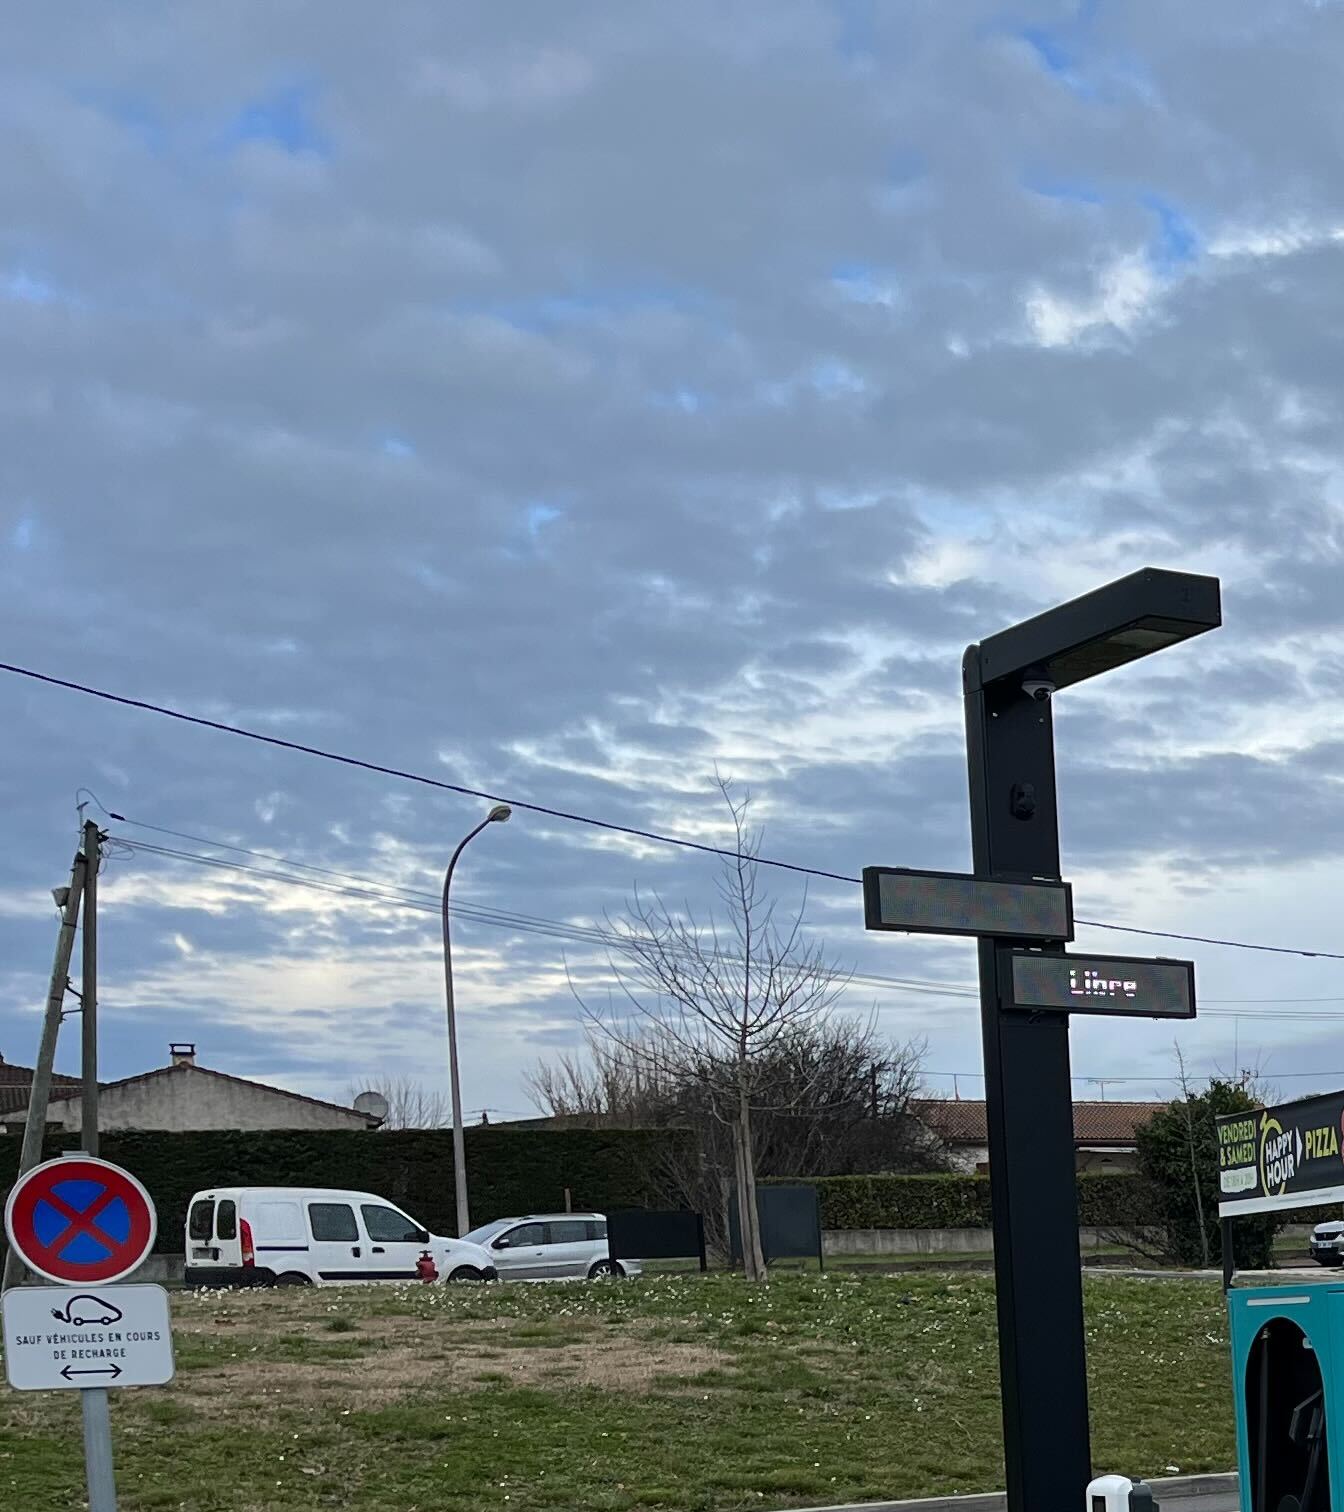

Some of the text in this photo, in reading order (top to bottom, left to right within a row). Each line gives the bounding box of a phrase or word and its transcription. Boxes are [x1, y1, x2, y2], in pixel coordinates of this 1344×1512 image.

[1217, 1119, 1257, 1145] VENDREDI
[1305, 1126, 1339, 1160] PIZZA
[1220, 1142, 1257, 1167] & SAMEDI
[1266, 1130, 1293, 1164] HAPPY
[1267, 1154, 1295, 1188] HOUR
[16, 1331, 161, 1345] SAUF VÉHICULES EN COURS
[53, 1348, 127, 1360] DE RECHARGE
